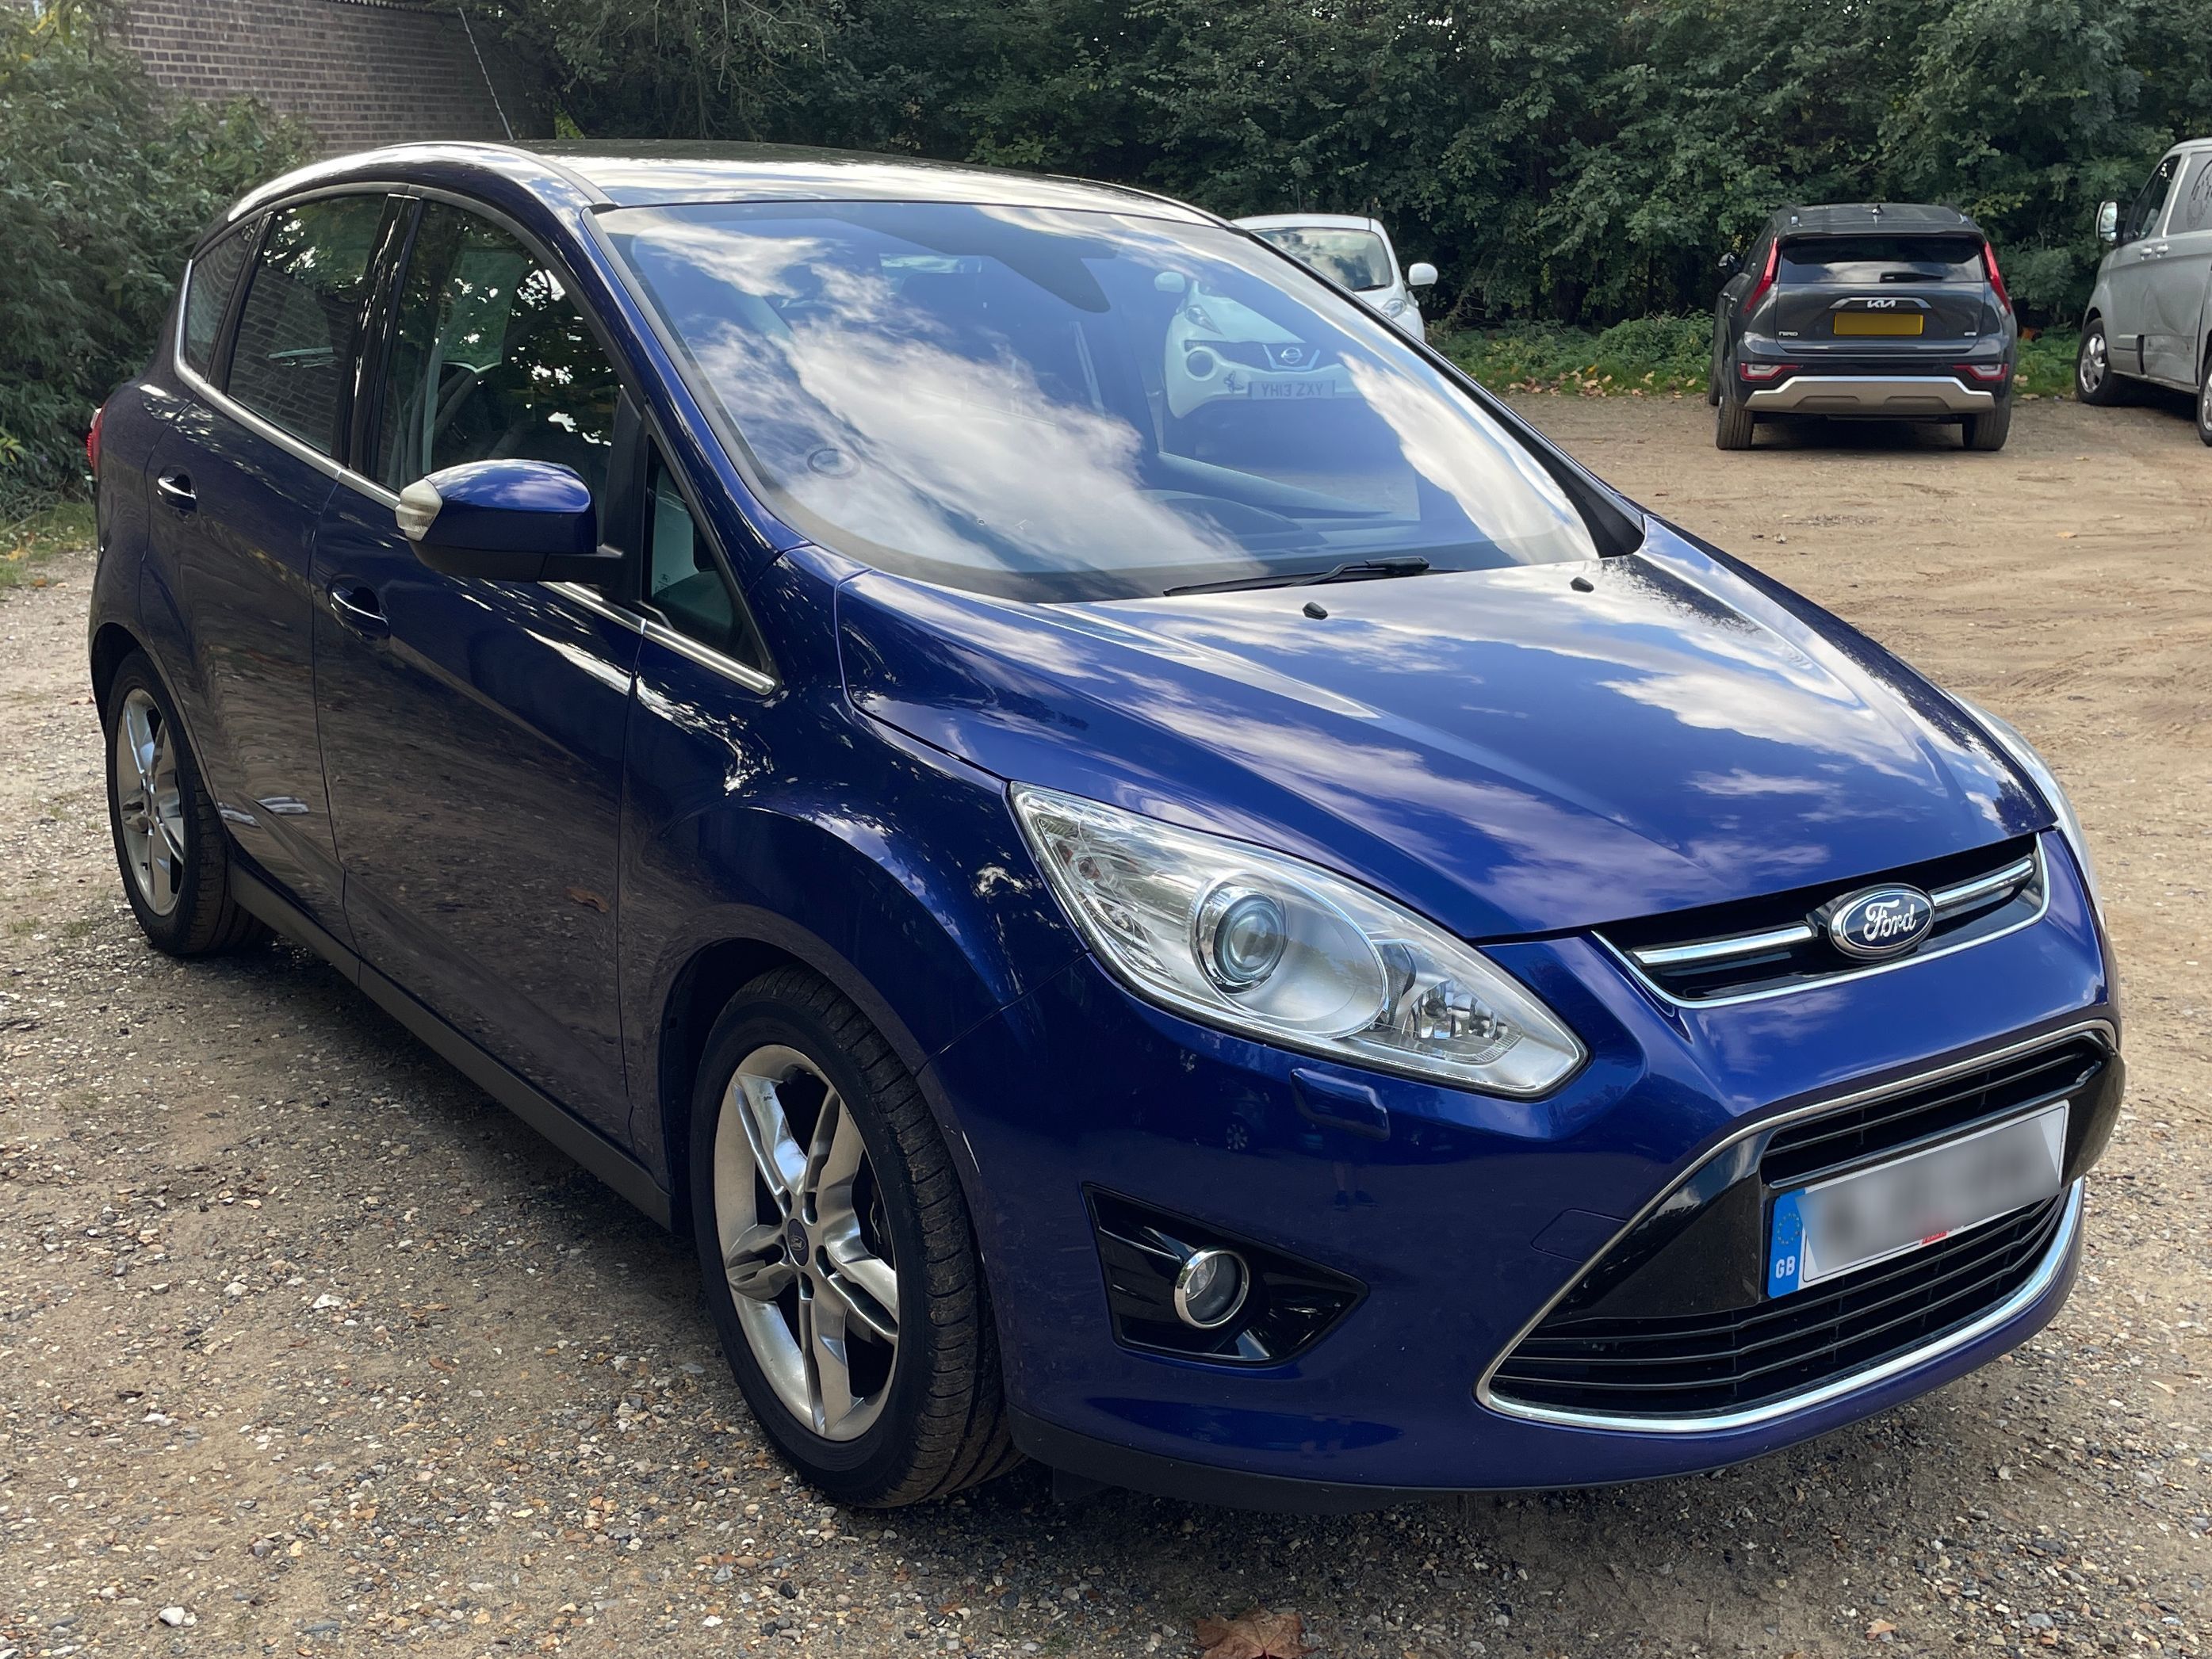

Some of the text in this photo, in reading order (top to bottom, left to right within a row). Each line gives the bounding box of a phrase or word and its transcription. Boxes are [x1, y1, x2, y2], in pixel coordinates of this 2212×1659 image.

[1867, 300, 1896, 308] KIA
[1261, 383, 1324, 397] YH13 ZXY
[1863, 899, 1917, 942] Ford
[1776, 1256, 1796, 1279] GB
